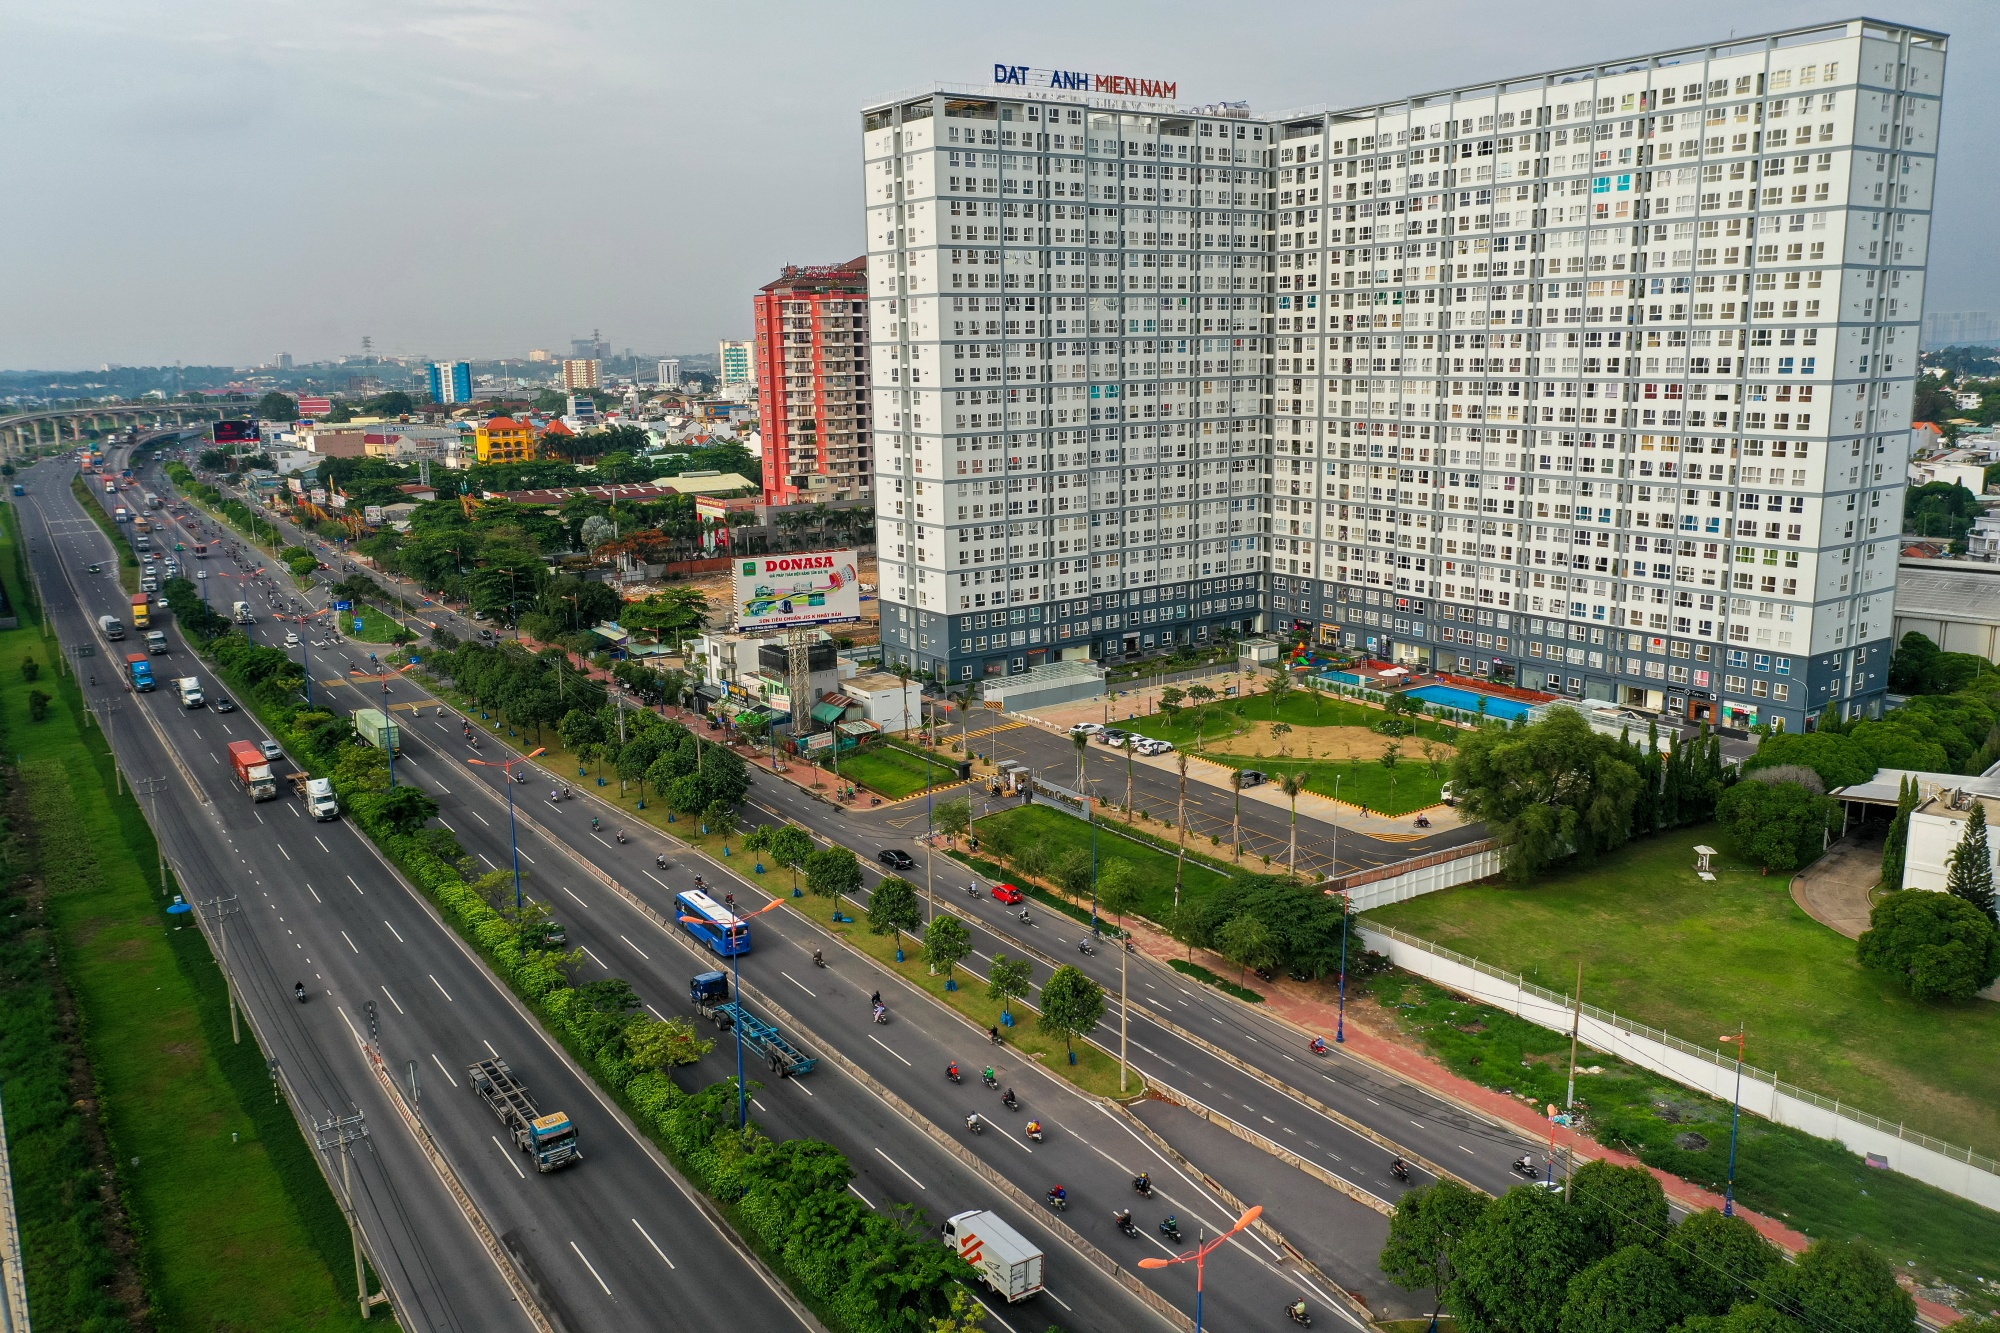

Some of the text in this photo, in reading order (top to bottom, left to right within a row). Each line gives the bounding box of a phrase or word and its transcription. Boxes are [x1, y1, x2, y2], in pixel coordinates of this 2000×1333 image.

[1095, 73, 1136, 95] MIEN
[1140, 78, 1177, 100] NAM
[765, 556, 834, 572] DONASA
